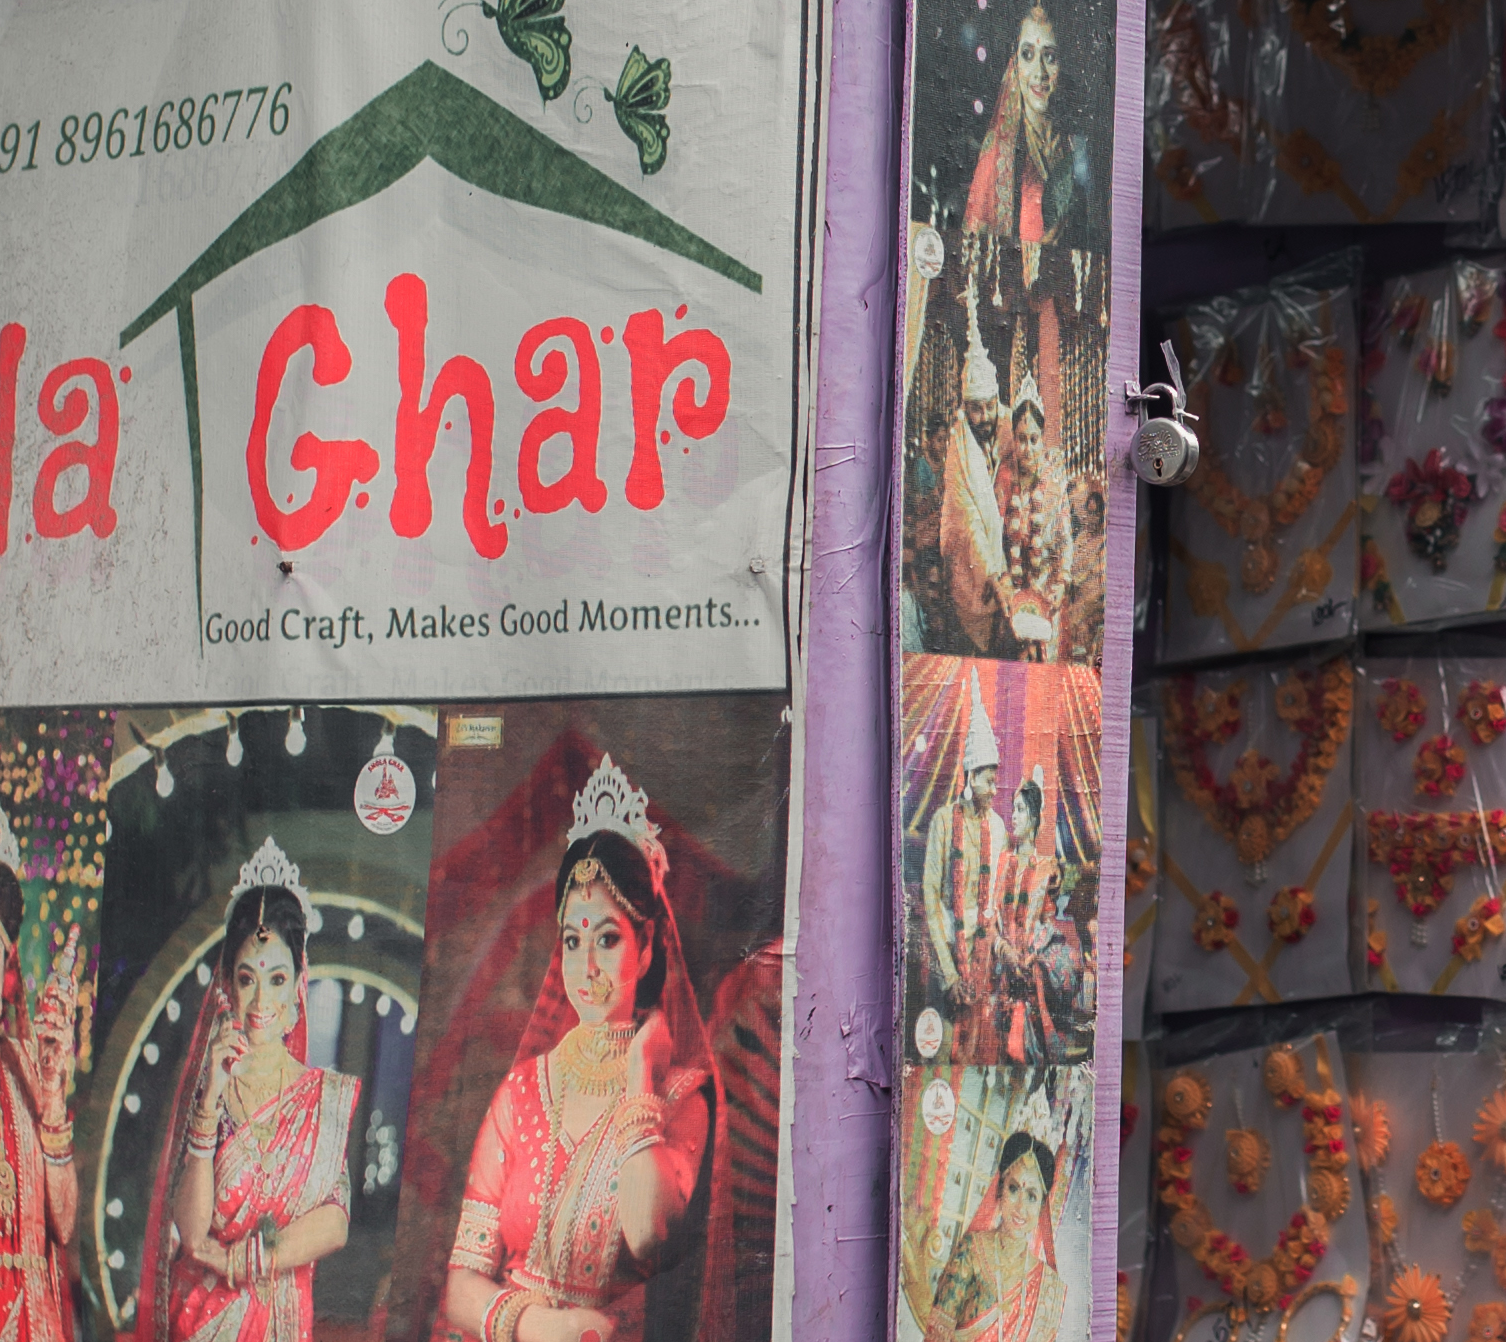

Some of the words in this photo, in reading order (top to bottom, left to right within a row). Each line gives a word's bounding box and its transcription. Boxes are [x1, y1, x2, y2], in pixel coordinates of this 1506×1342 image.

[54, 82, 293, 167] 8961686776
[246, 272, 734, 561] Ghar
[205, 608, 271, 645] Good
[279, 606, 375, 649] Craft,
[385, 605, 491, 640] Makes
[499, 599, 570, 637] Good
[577, 597, 762, 633] Moments...
